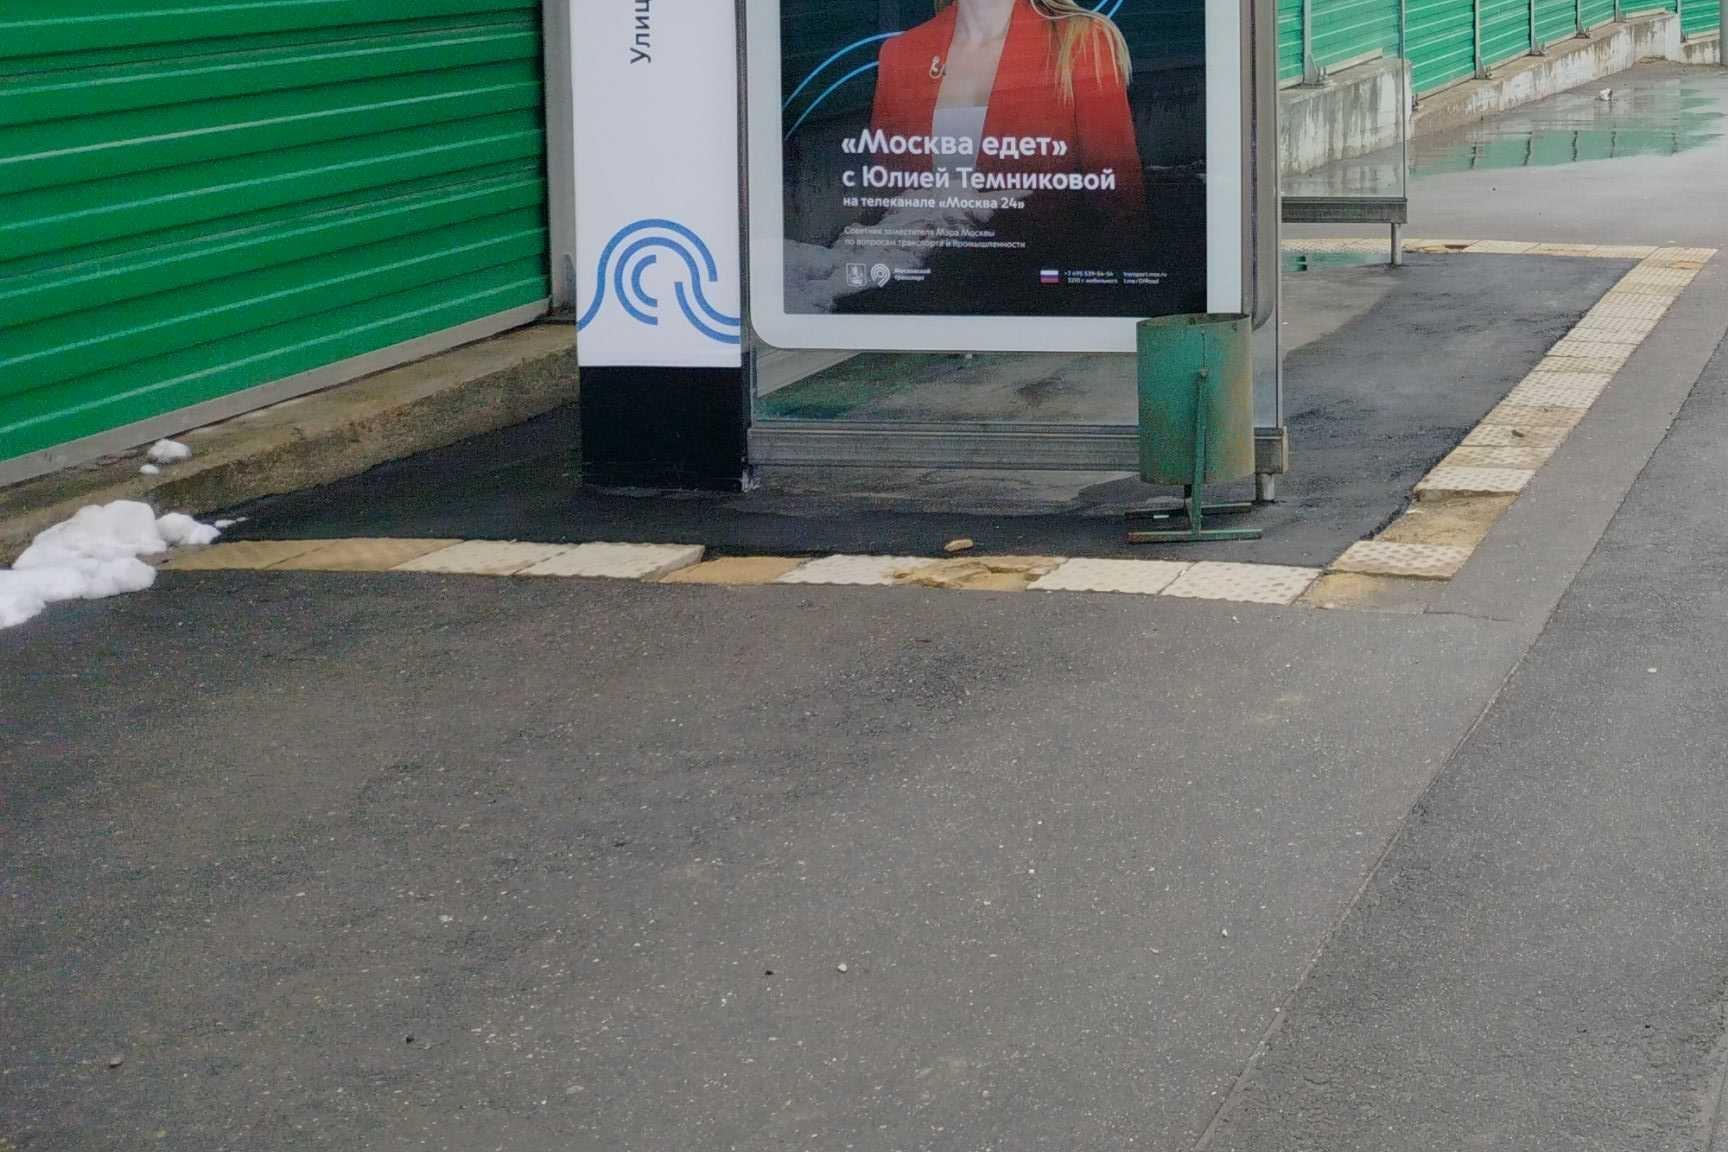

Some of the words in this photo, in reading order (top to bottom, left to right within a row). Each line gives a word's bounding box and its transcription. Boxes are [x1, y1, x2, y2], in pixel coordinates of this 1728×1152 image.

[841, 128, 973, 156] «Москва
[982, 135, 1068, 160] едет»
[842, 170, 856, 188] с
[862, 165, 950, 189] Юлией
[956, 166, 1117, 191] Темниковой
[843, 197, 859, 207] на
[861, 197, 936, 209] телеканале
[938, 196, 998, 209] «Москва
[1000, 197, 1025, 209] 24»
